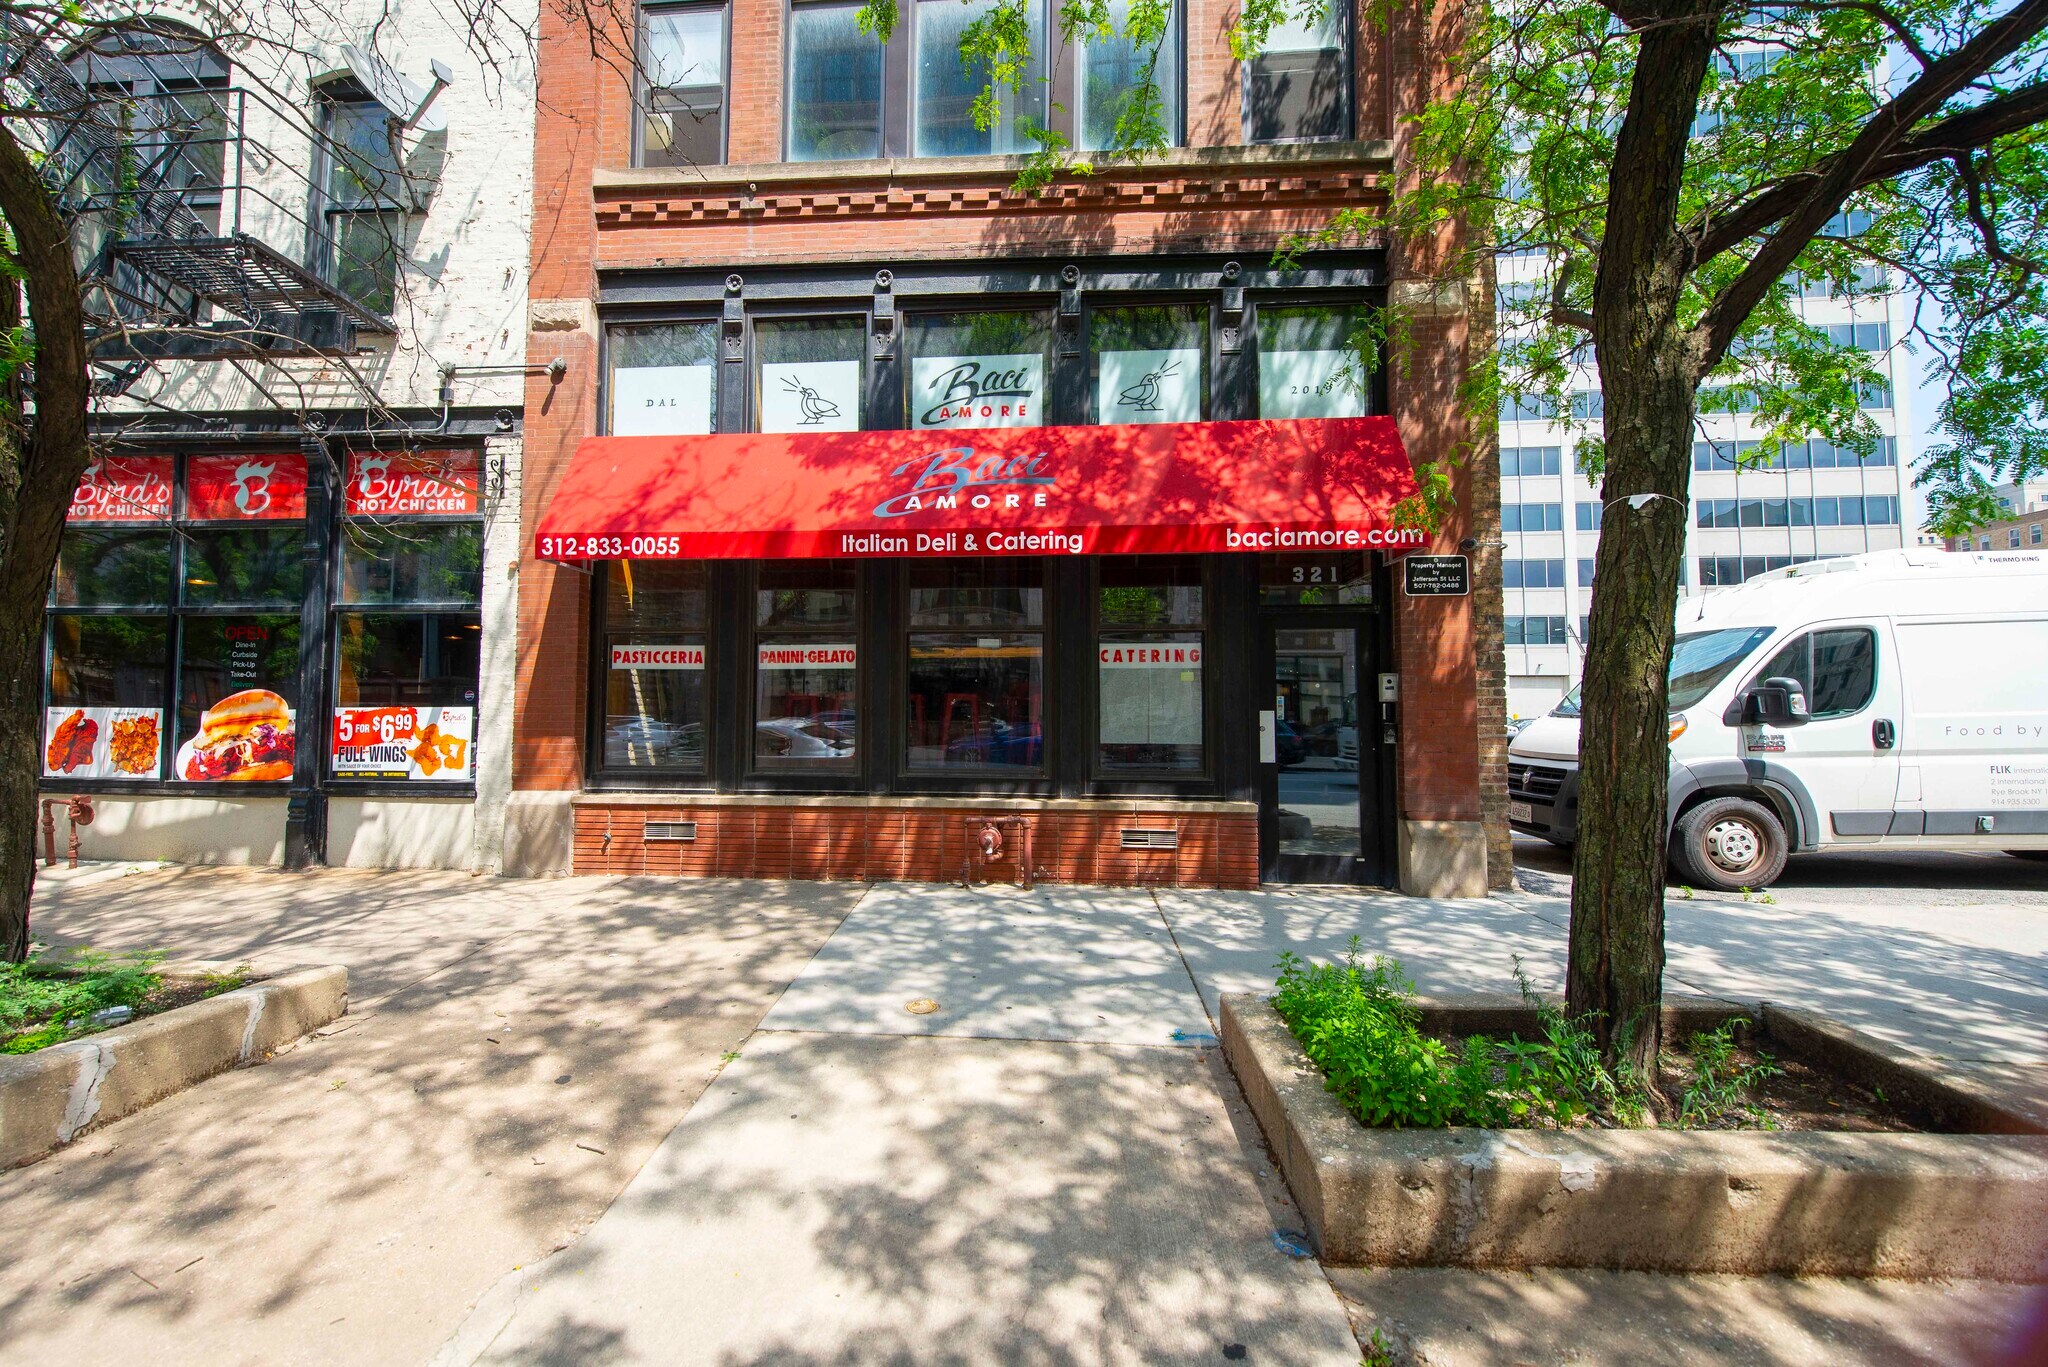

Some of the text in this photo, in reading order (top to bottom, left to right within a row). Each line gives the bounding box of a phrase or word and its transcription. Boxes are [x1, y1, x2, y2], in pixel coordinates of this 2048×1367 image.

[927, 362, 1029, 408] Baci
[1291, 385, 1333, 395] 2019
[645, 398, 677, 408] DAL
[940, 404, 1028, 419] AMORE
[890, 447, 1050, 496] Baci
[356, 498, 466, 511] HOT CHICKEN
[905, 493, 1047, 510] AMORE
[68, 504, 170, 516] HOT CHICKEN
[842, 530, 1083, 554] Italian Deli & Catering
[1226, 527, 1425, 548] baciamore.com
[541, 537, 680, 556] 312-833-0055
[1292, 566, 1338, 583] 321
[224, 626, 269, 640] OPEN
[612, 650, 704, 664] PASTICCERIA
[1099, 649, 1200, 663] CATERING
[339, 714, 353, 741] 5
[355, 724, 370, 733] FOR
[1945, 724, 2043, 738] Food by
[338, 746, 407, 762] FULL WINGS
[1990, 765, 2011, 774] FLIK
